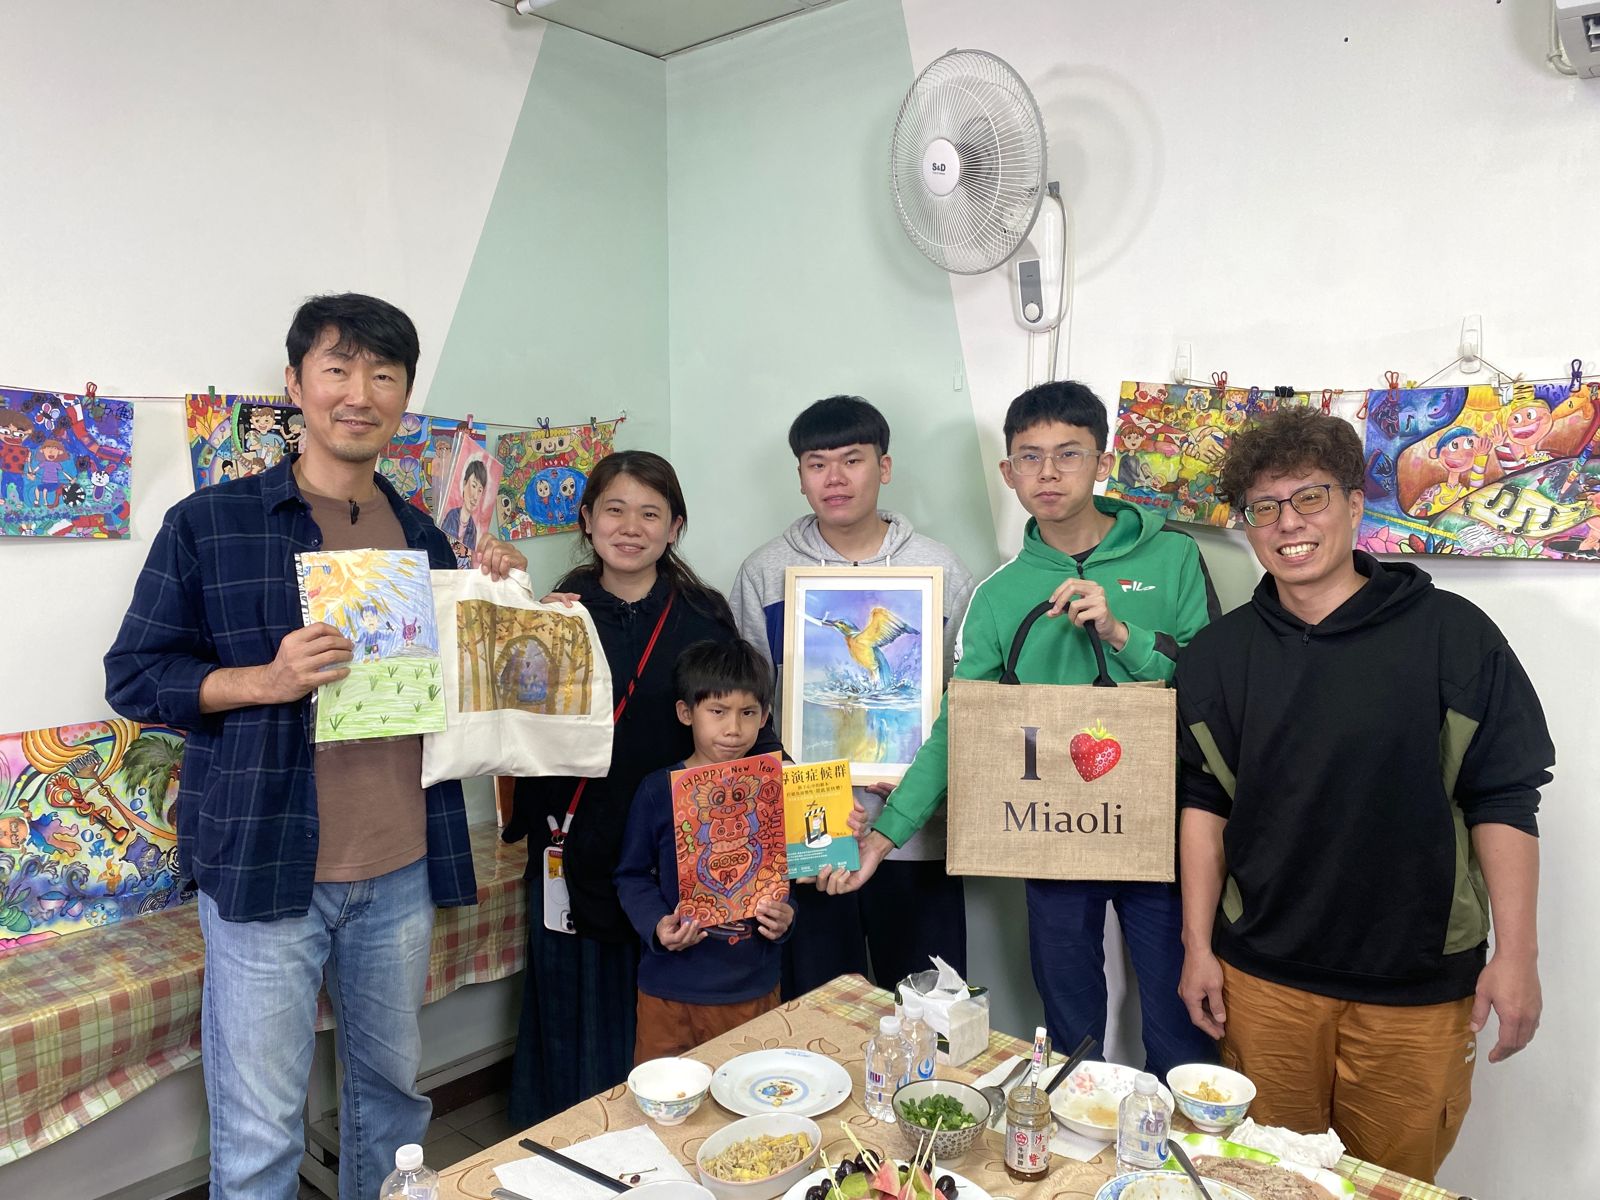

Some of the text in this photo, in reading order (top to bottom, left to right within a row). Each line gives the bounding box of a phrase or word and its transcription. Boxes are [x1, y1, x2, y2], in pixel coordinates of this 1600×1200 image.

[932, 162, 946, 172] S&D
[1020, 726, 1041, 781] I
[682, 761, 775, 790] HAPPY New Year
[1002, 801, 1124, 834] Miaoli
